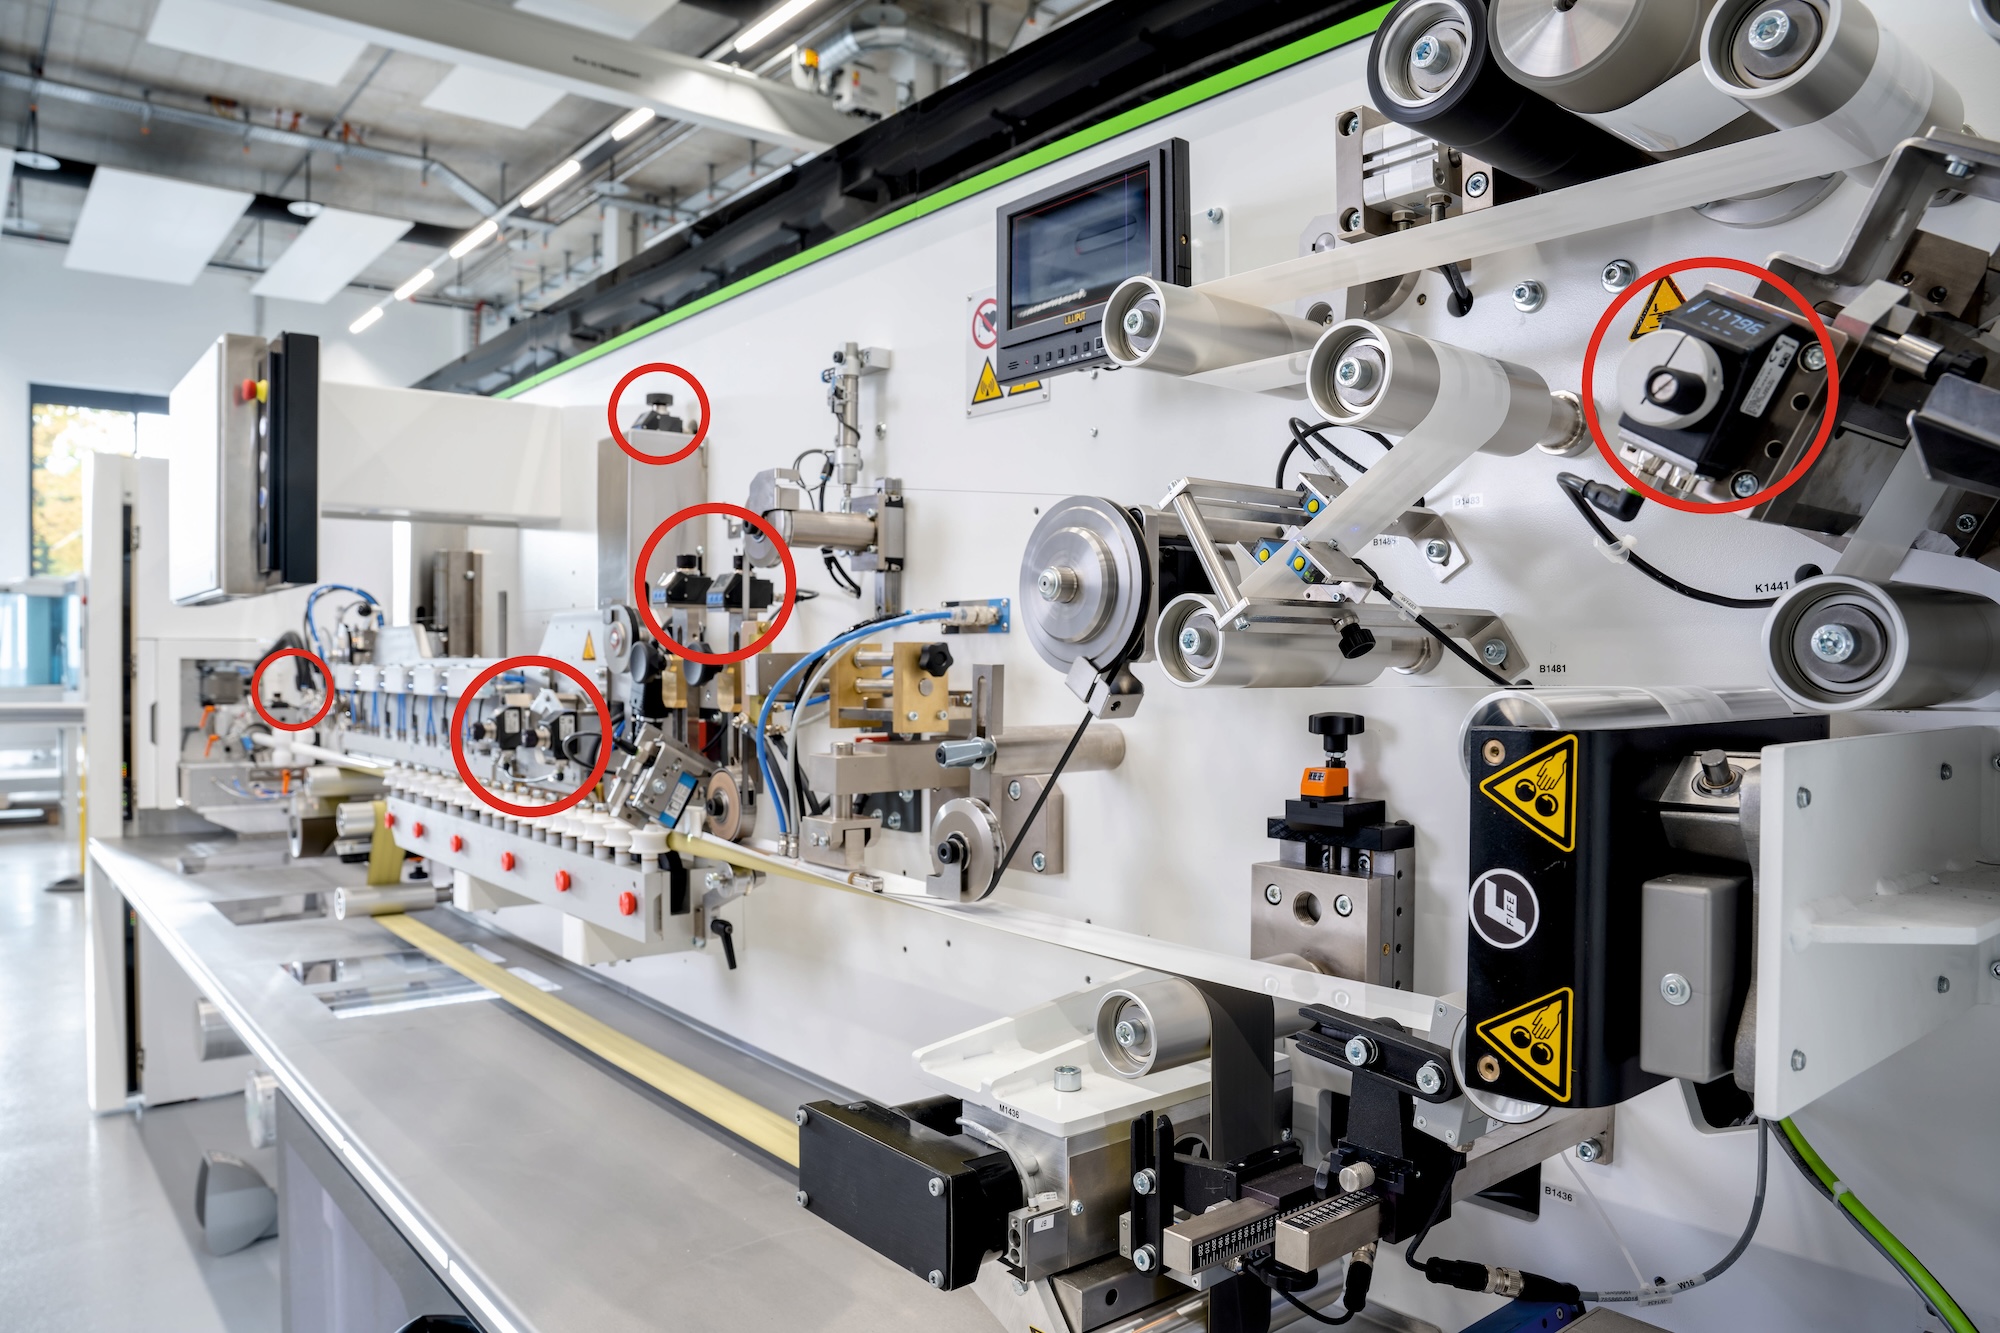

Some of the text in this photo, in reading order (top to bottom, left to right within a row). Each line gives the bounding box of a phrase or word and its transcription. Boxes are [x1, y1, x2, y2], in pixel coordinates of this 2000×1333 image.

[1064, 311, 1086, 325] LILLIPUT
[1707, 308, 1765, 335] 17796
[1755, 581, 1789, 593] K1441
[1539, 664, 1566, 673] B1481
[1506, 896, 1515, 927] FIFE
[999, 1103, 1019, 1119] M1436
[1544, 1186, 1573, 1202] B1436
[1677, 1279, 1695, 1289] W16
